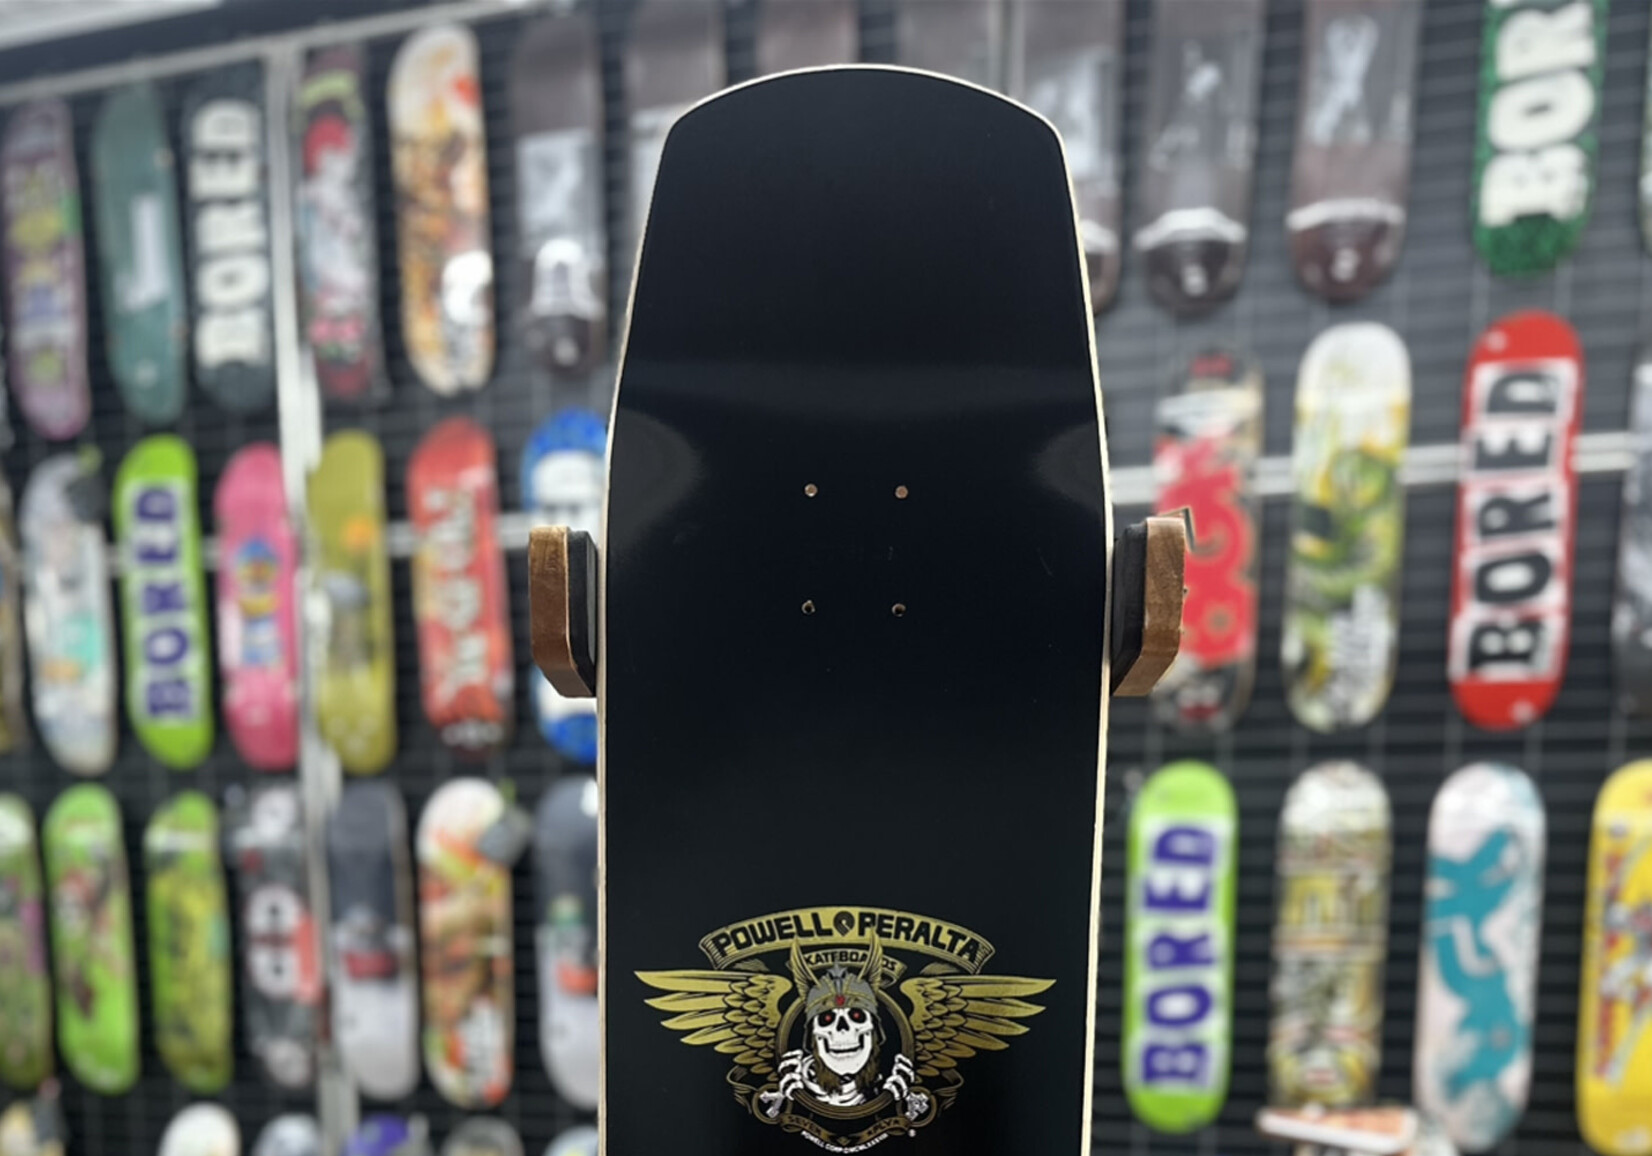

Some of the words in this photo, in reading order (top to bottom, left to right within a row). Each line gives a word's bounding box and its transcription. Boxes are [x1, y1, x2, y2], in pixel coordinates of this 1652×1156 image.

[1480, 0, 1595, 227] BOR
[136, 487, 191, 717] BORED
[1468, 371, 1562, 679] BORED
[713, 911, 834, 958] POWELL
[857, 911, 982, 964] PERALTA
[1141, 825, 1218, 1087] BORED
